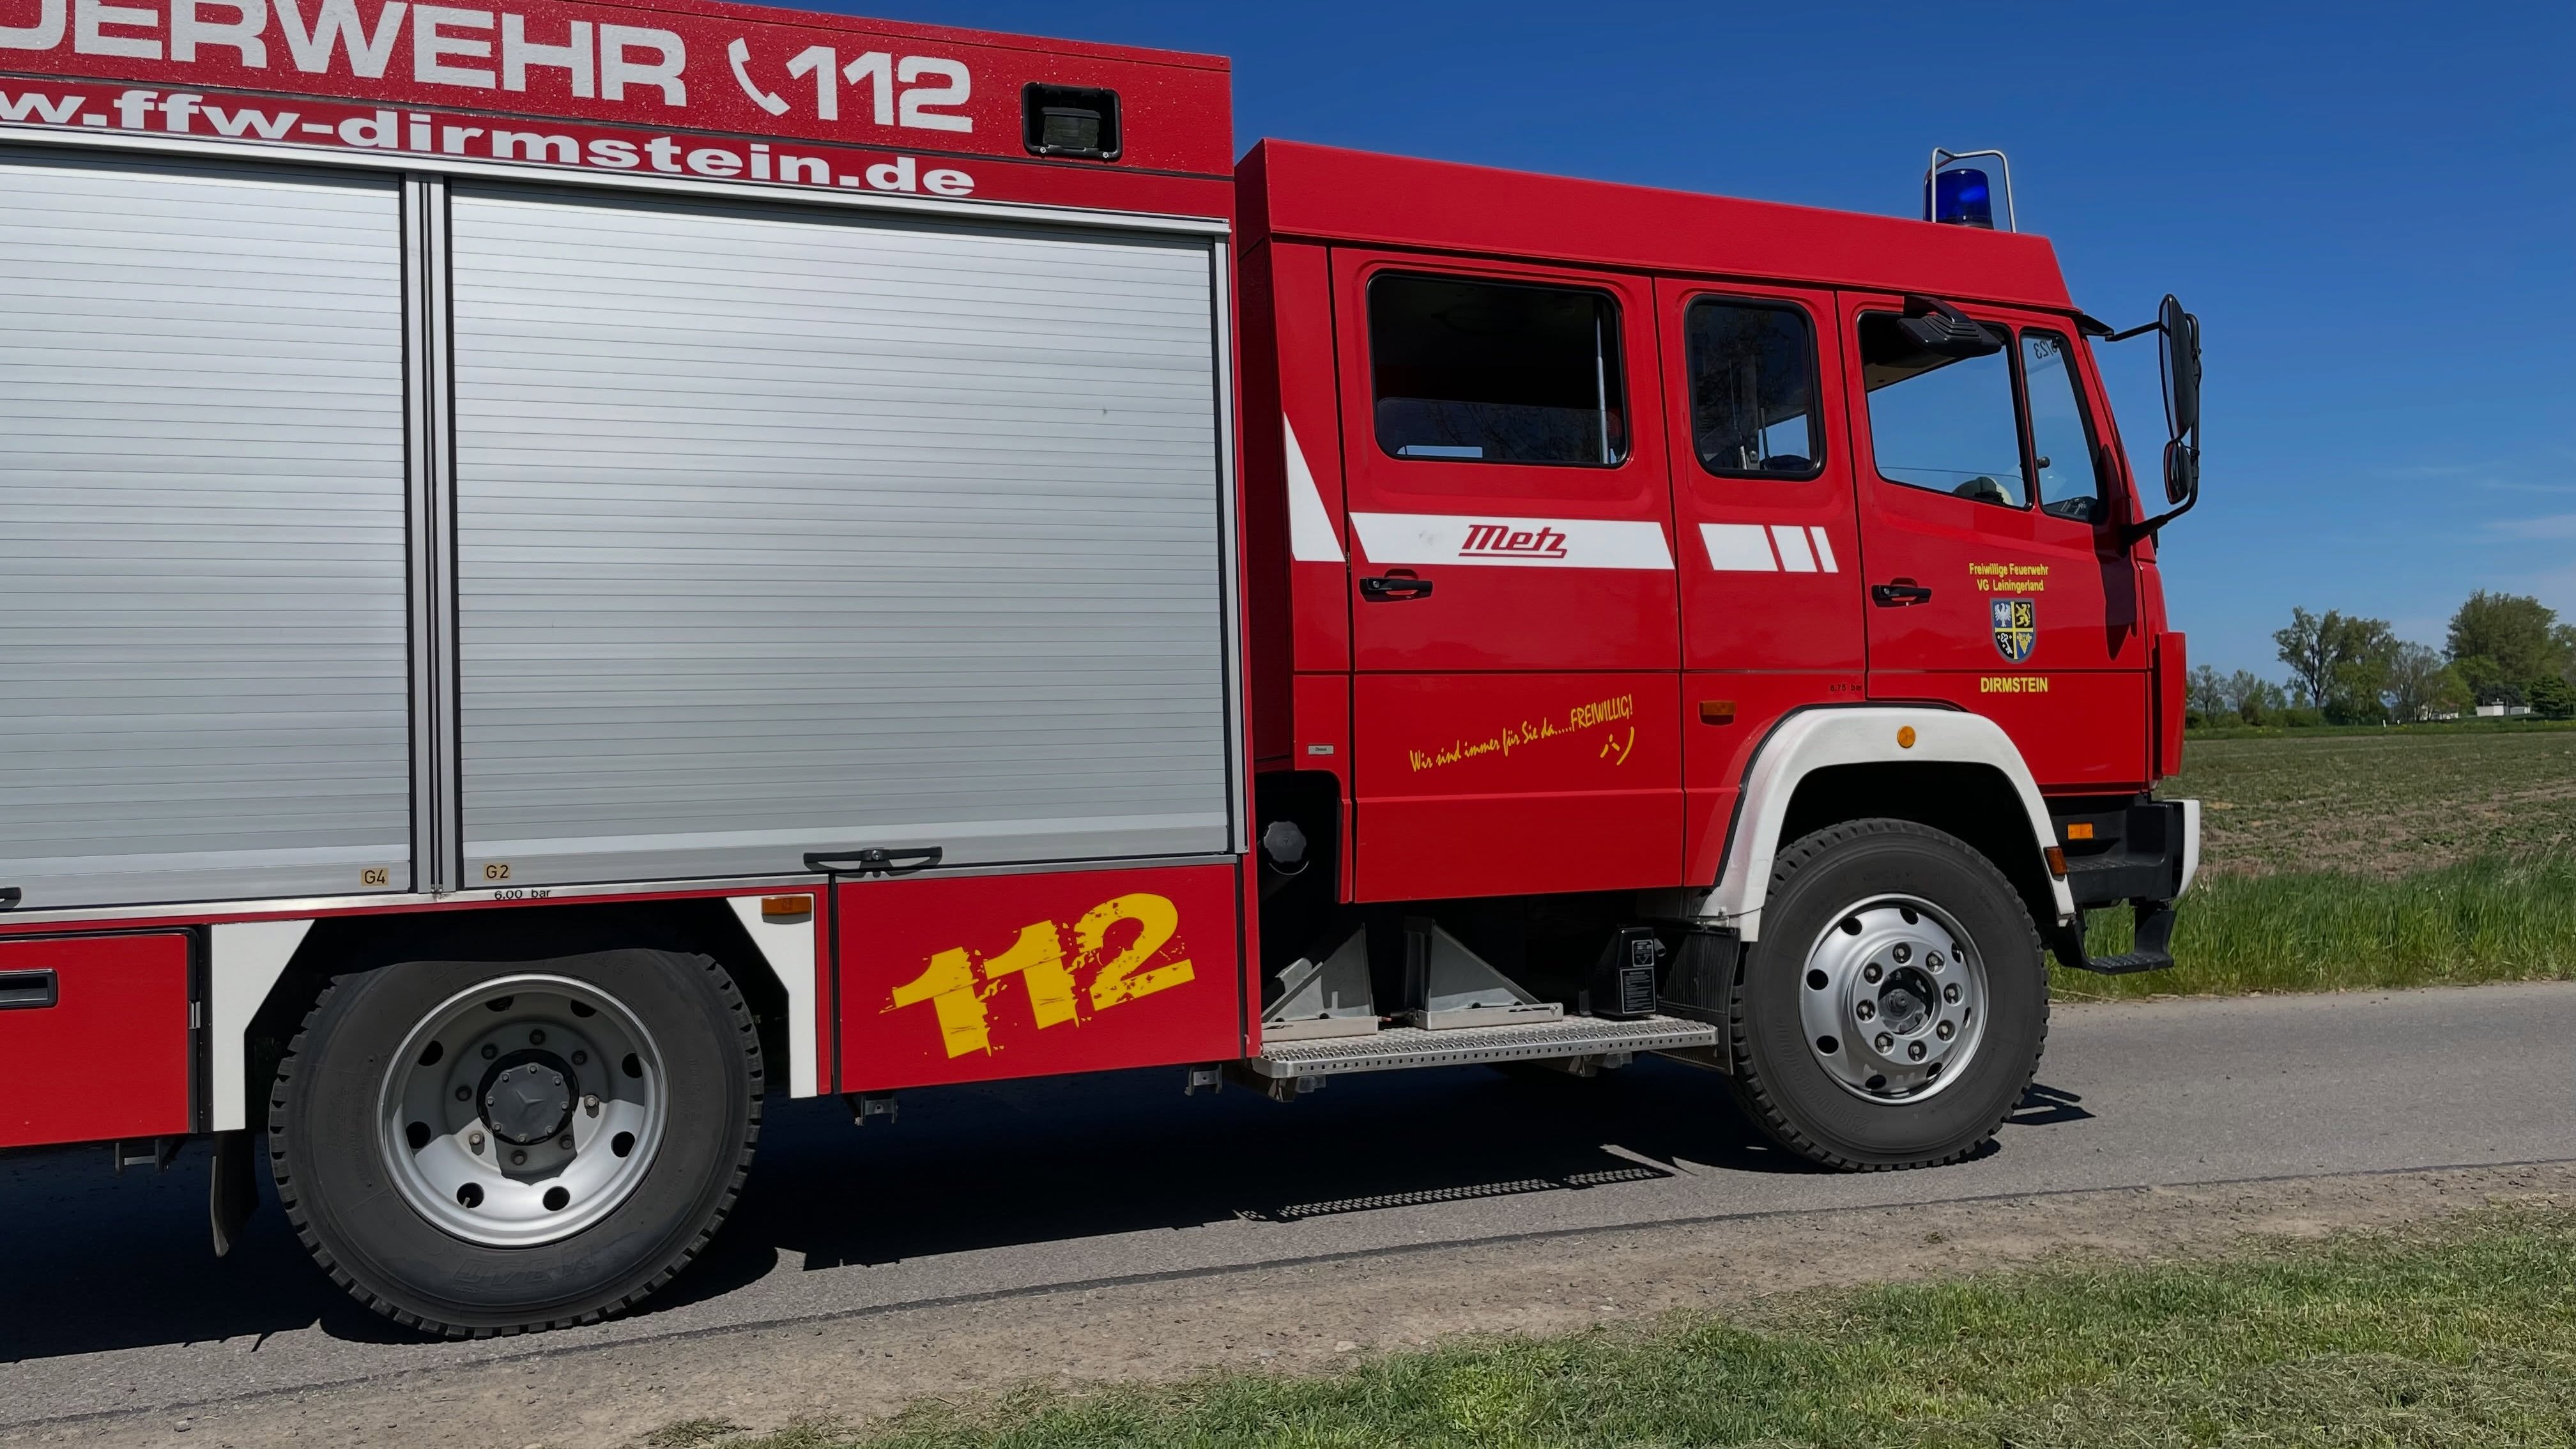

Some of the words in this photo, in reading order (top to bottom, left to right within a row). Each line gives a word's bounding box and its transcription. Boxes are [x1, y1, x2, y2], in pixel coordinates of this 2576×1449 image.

[785, 45, 973, 133] 112
[1459, 525, 1568, 558] Metz
[1969, 562, 2008, 578] Freiwillige
[2009, 563, 2049, 576] Feuerwehr
[1977, 578, 1990, 591] VG
[1993, 579, 2044, 594] Leiningerland
[1981, 677, 2048, 693] DIRMSTEIN
[1409, 749, 1433, 772] Wir
[1436, 739, 1462, 767] sind
[1464, 738, 1500, 758] immer
[1503, 727, 1520, 757] für
[1522, 719, 1538, 744] Sie
[364, 870, 385, 884] G4
[494, 890, 523, 901] 6.00
[531, 889, 551, 898] bar
[879, 893, 1195, 1059] 112
